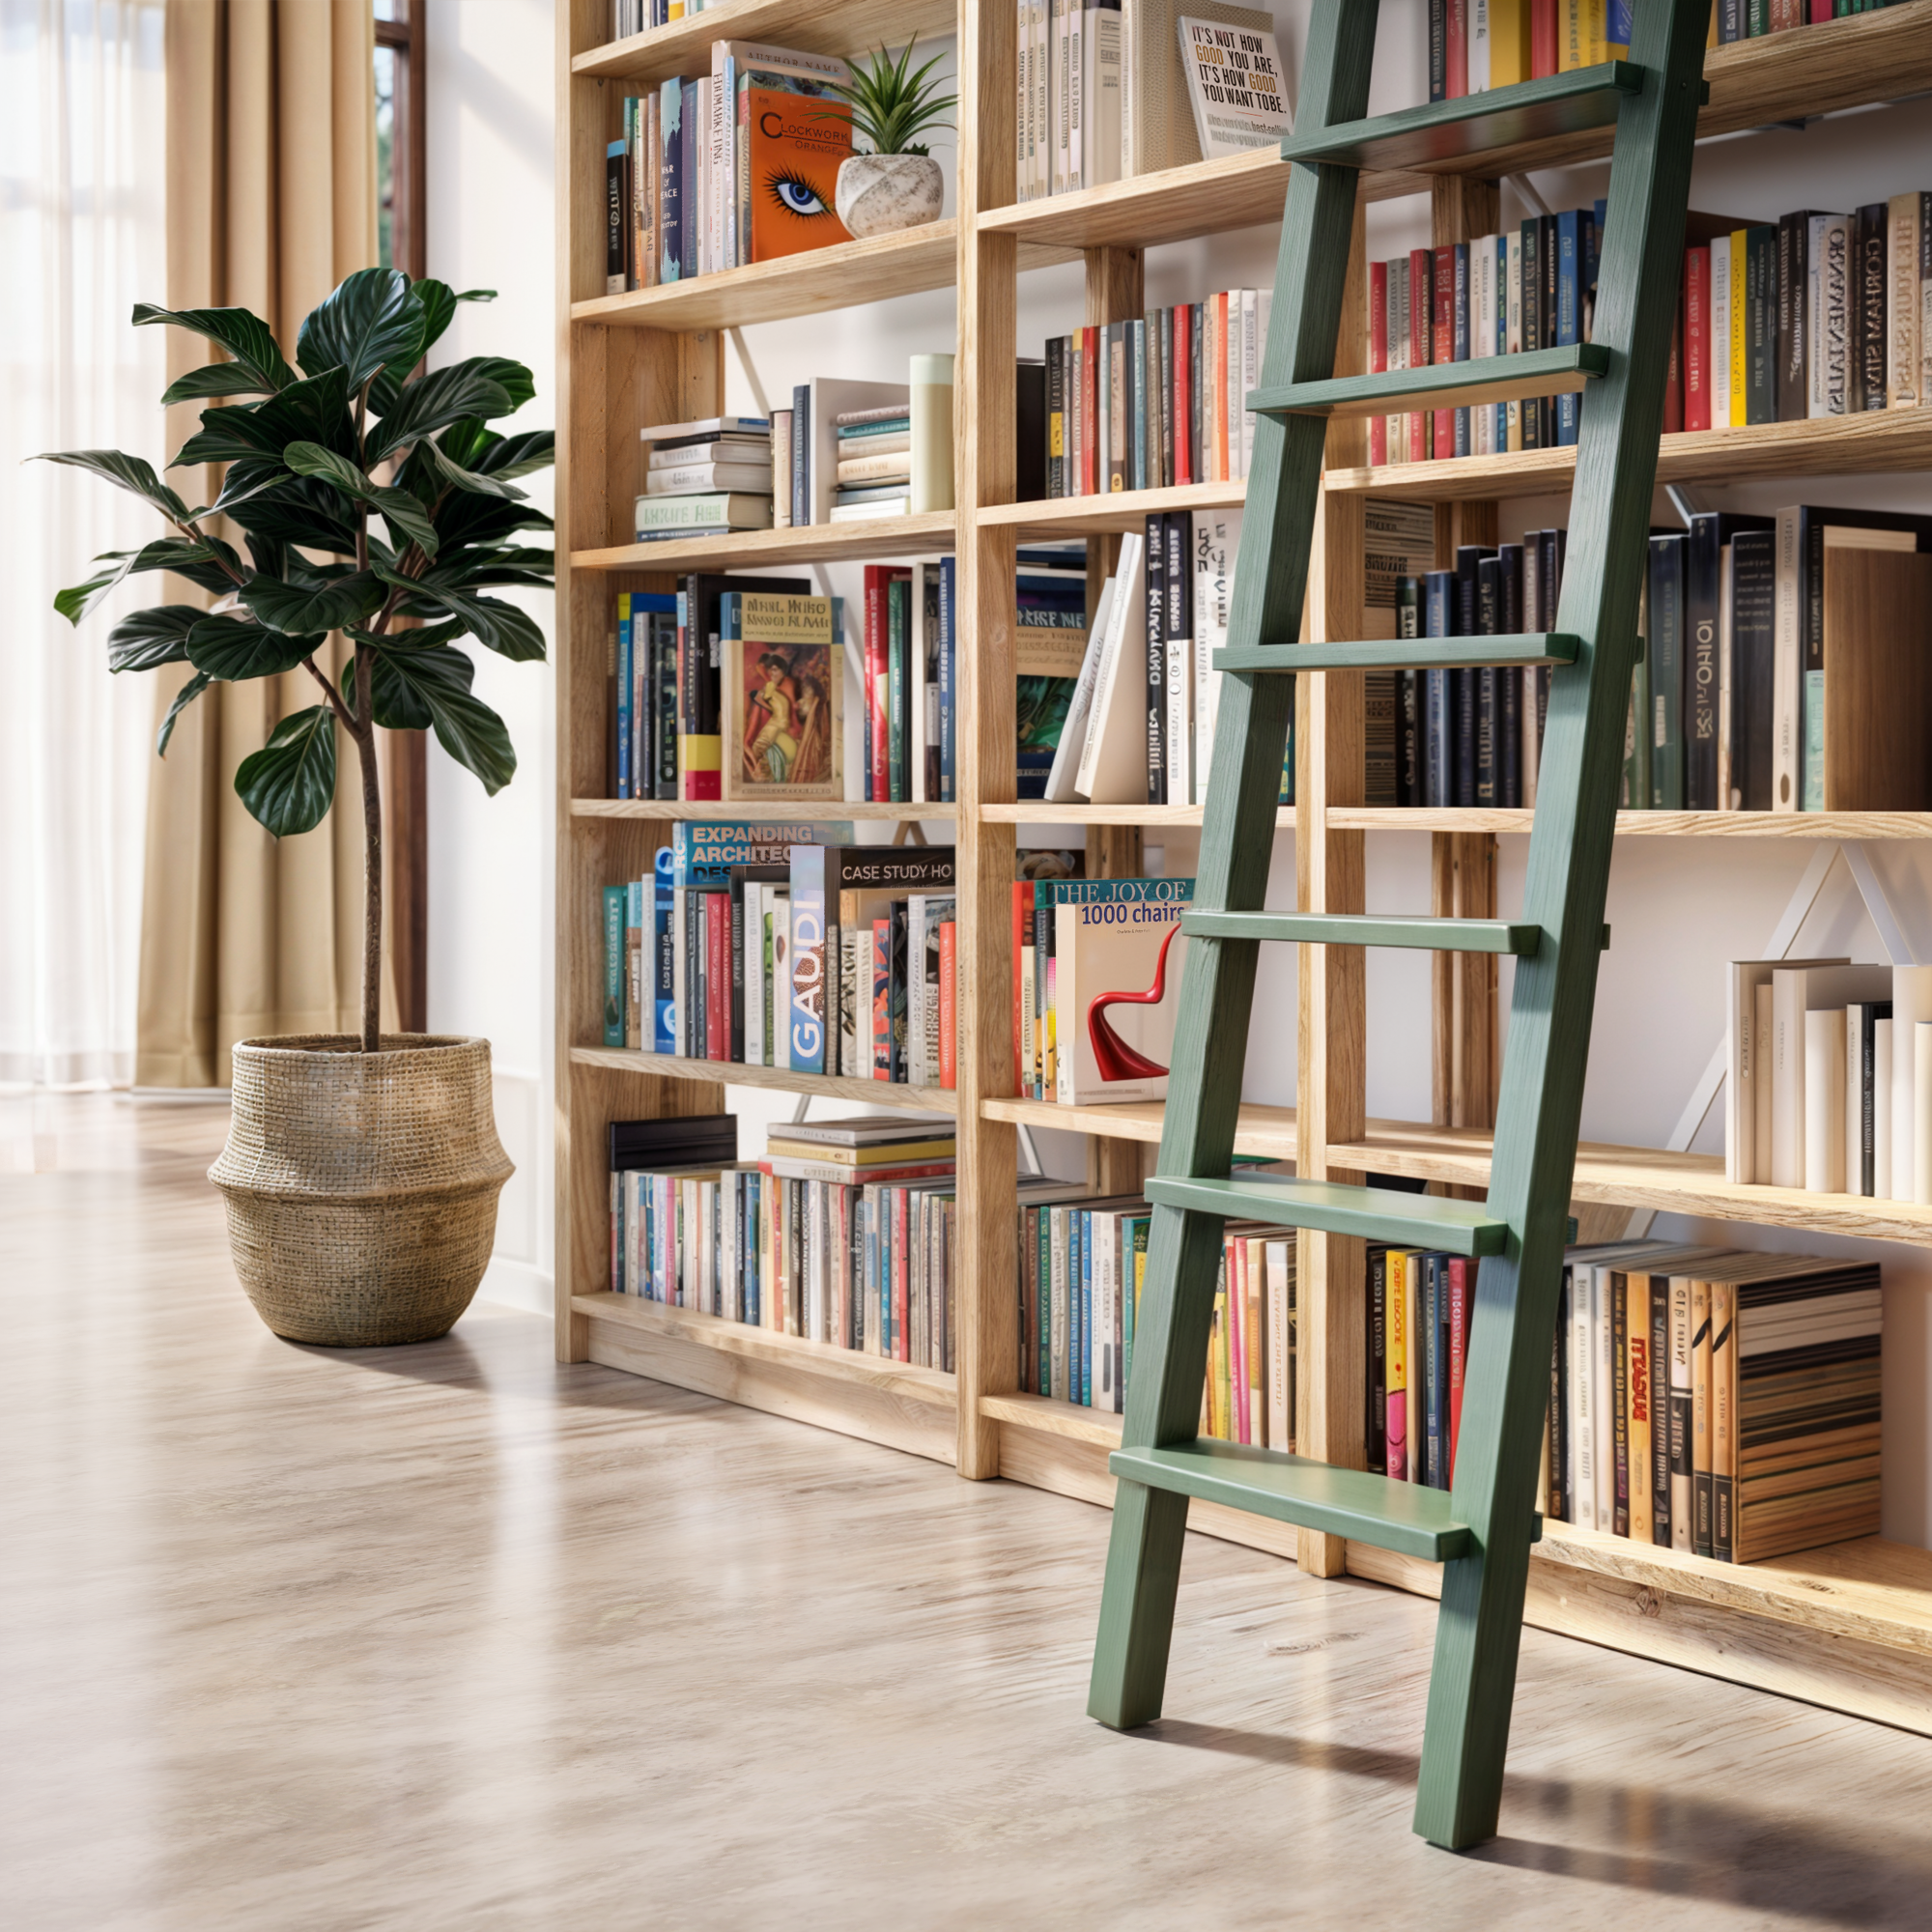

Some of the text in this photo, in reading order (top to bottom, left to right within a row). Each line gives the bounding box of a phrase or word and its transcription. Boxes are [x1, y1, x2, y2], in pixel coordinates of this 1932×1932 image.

[1192, 25, 1264, 54] IT'S NOT HOW
[1195, 44, 1278, 77] GOOD YOU ARE,
[1199, 63, 1277, 93] IT'S HOW GOOD
[1202, 83, 1225, 103] YOU
[1225, 87, 1255, 108] WANT
[759, 111, 850, 143] CLOCKWORK
[794, 139, 838, 155] ORANGE
[692, 826, 812, 843] EXPANDING
[841, 866, 880, 880] CASE
[883, 865, 928, 880] STUDY
[1049, 881, 1186, 904] THE JOY OF
[1081, 904, 1128, 924] 1000
[792, 900, 821, 1059] GAUDI
